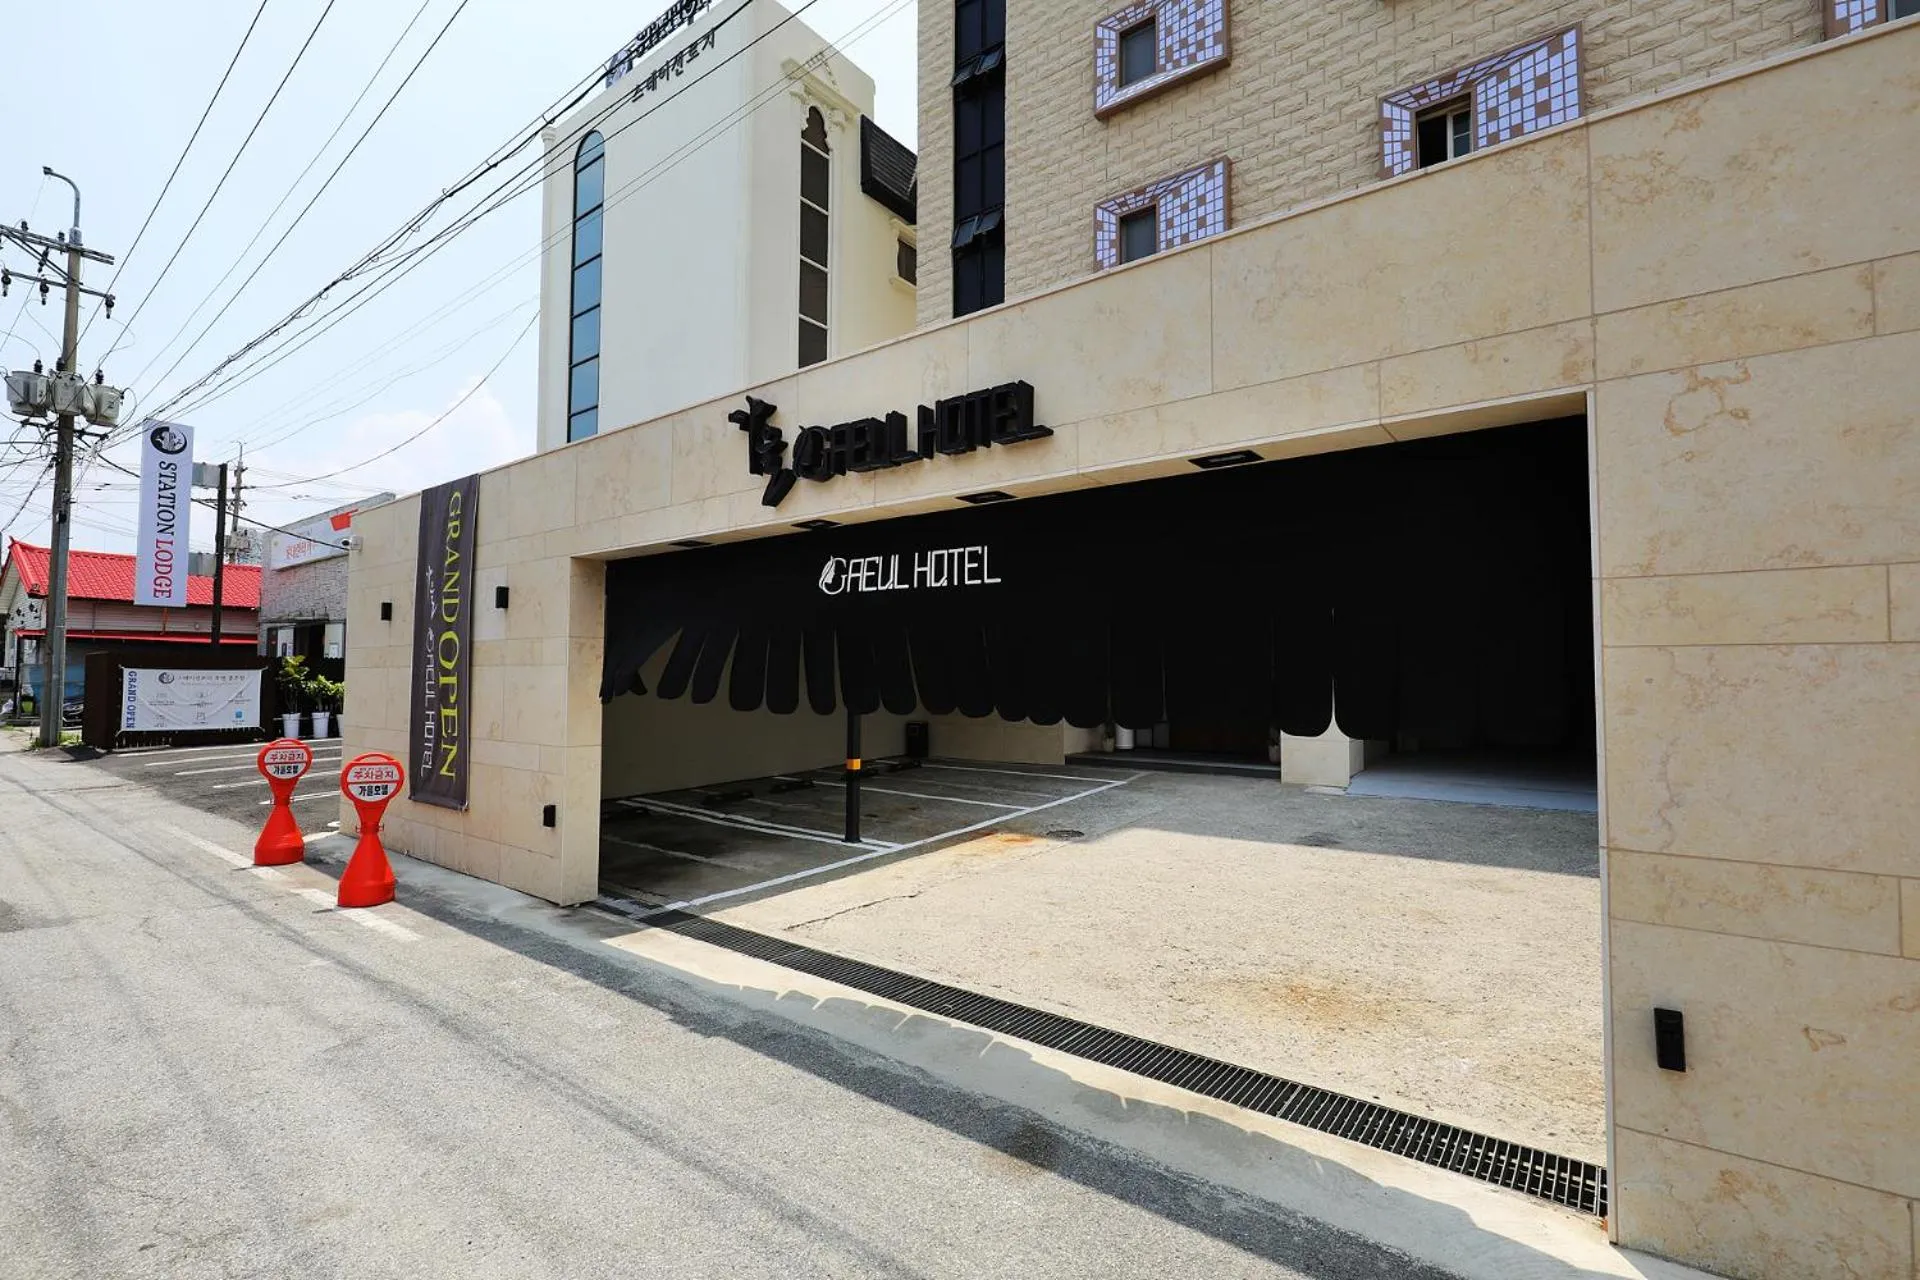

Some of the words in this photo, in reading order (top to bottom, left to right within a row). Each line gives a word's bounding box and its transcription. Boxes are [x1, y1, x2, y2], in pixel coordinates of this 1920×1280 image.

[918, 379, 1054, 460] HOTEL
[156, 460, 178, 536] STATION
[153, 538, 174, 599] LODGE
[442, 491, 462, 623] GRAND
[818, 554, 909, 595] GAEUL
[914, 545, 1002, 589] HOTEL
[126, 704, 137, 729] OPEN
[127, 670, 138, 703] GRAND
[438, 630, 460, 783] OPEN
[270, 751, 305, 763] 주차금지
[353, 769, 394, 780] 주차금지
[420, 711, 435, 777] HOTEL
